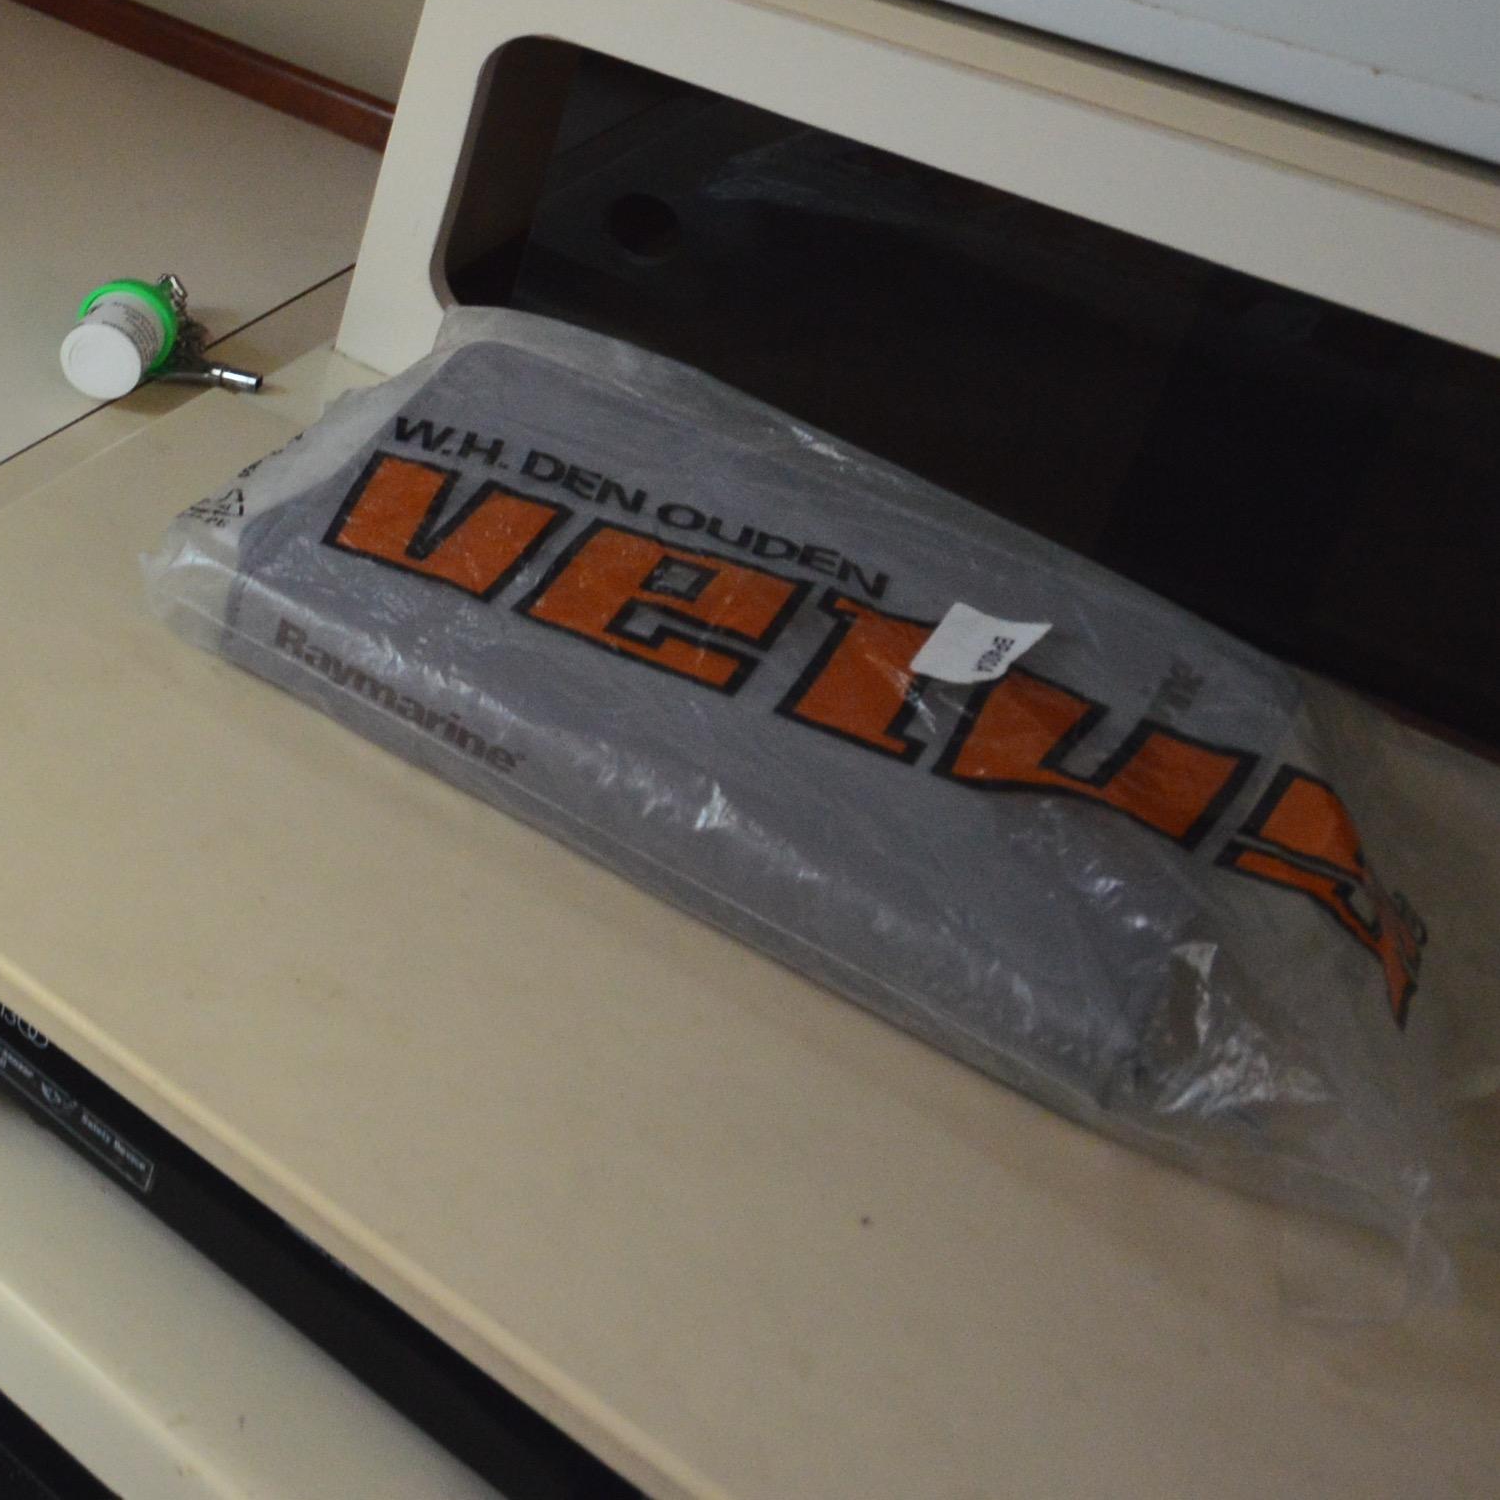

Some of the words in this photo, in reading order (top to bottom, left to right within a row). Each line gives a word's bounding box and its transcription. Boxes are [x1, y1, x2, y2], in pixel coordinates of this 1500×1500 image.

[393, 415, 509, 471] W.H.
[519, 449, 649, 515] DEN
[656, 503, 891, 600] OUDEN
[274, 616, 518, 774] Raymarine
